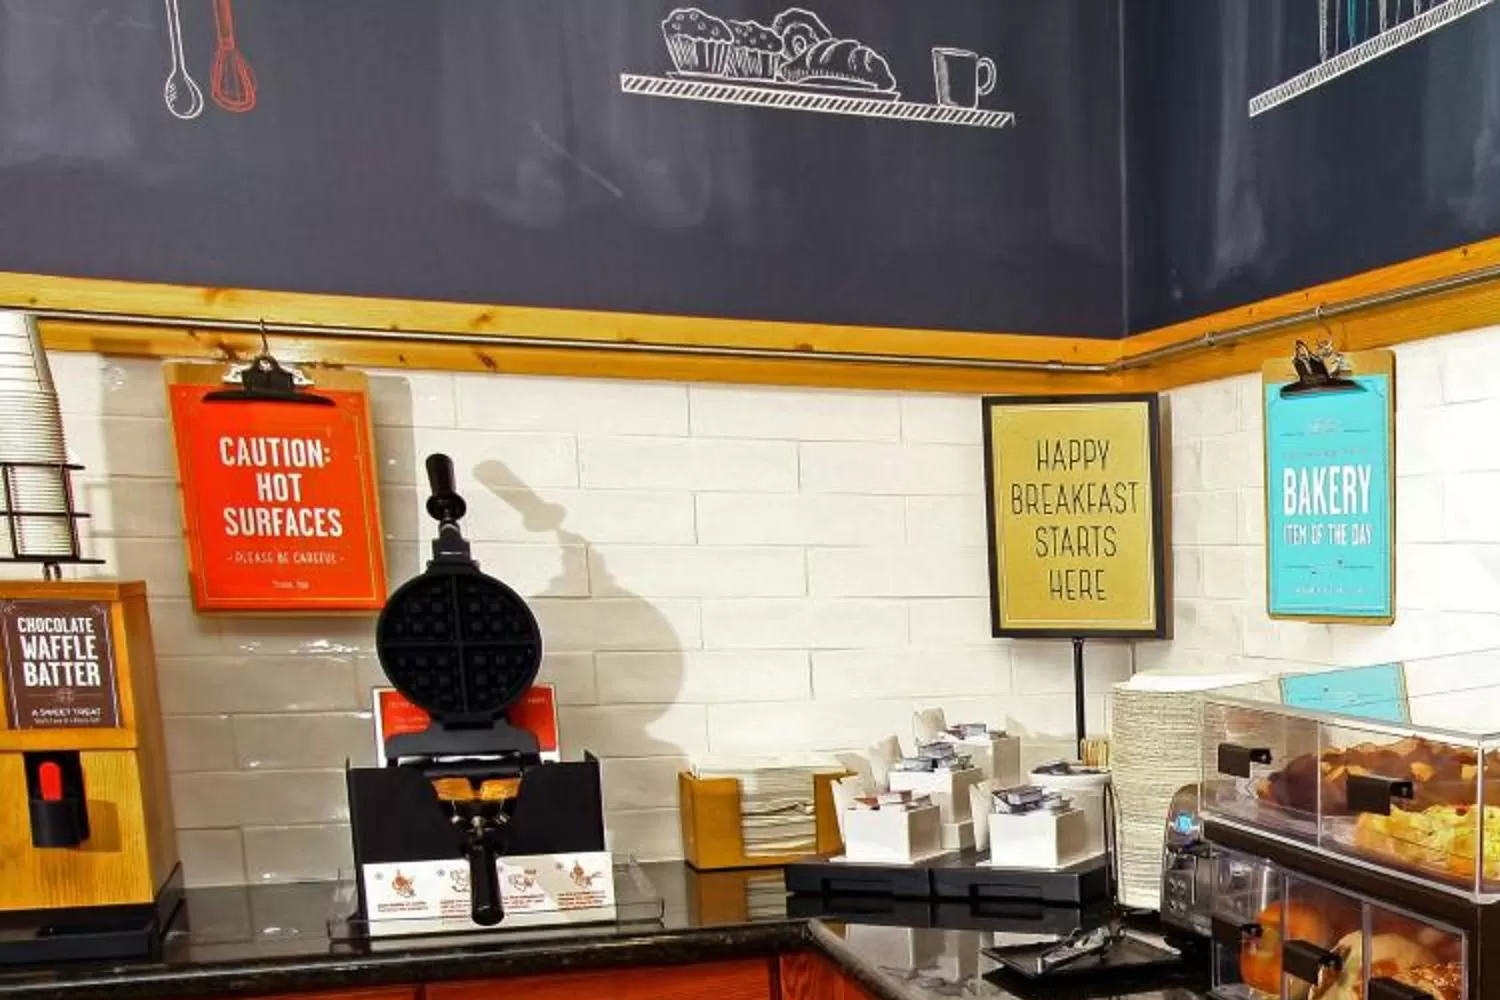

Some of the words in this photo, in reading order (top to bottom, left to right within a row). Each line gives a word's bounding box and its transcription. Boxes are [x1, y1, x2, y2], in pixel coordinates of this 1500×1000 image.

[219, 436, 332, 468] CAUTION:
[1036, 439, 1110, 472] HAPPY
[256, 471, 303, 503] HOT
[1011, 481, 1139, 516] BREAKFAST
[1283, 464, 1372, 517] BAKERY
[223, 507, 344, 538] SURFACES
[1283, 524, 1308, 545] ITEM
[1311, 523, 1325, 545] OF
[1327, 523, 1348, 545] THE
[1351, 522, 1373, 545] DAY
[1035, 525, 1118, 558] STARTS
[1049, 568, 1108, 602] HERE
[17, 617, 95, 633] CHOCOLATE
[20, 635, 99, 660] WAFFLE
[23, 661, 101, 687] BATTER
